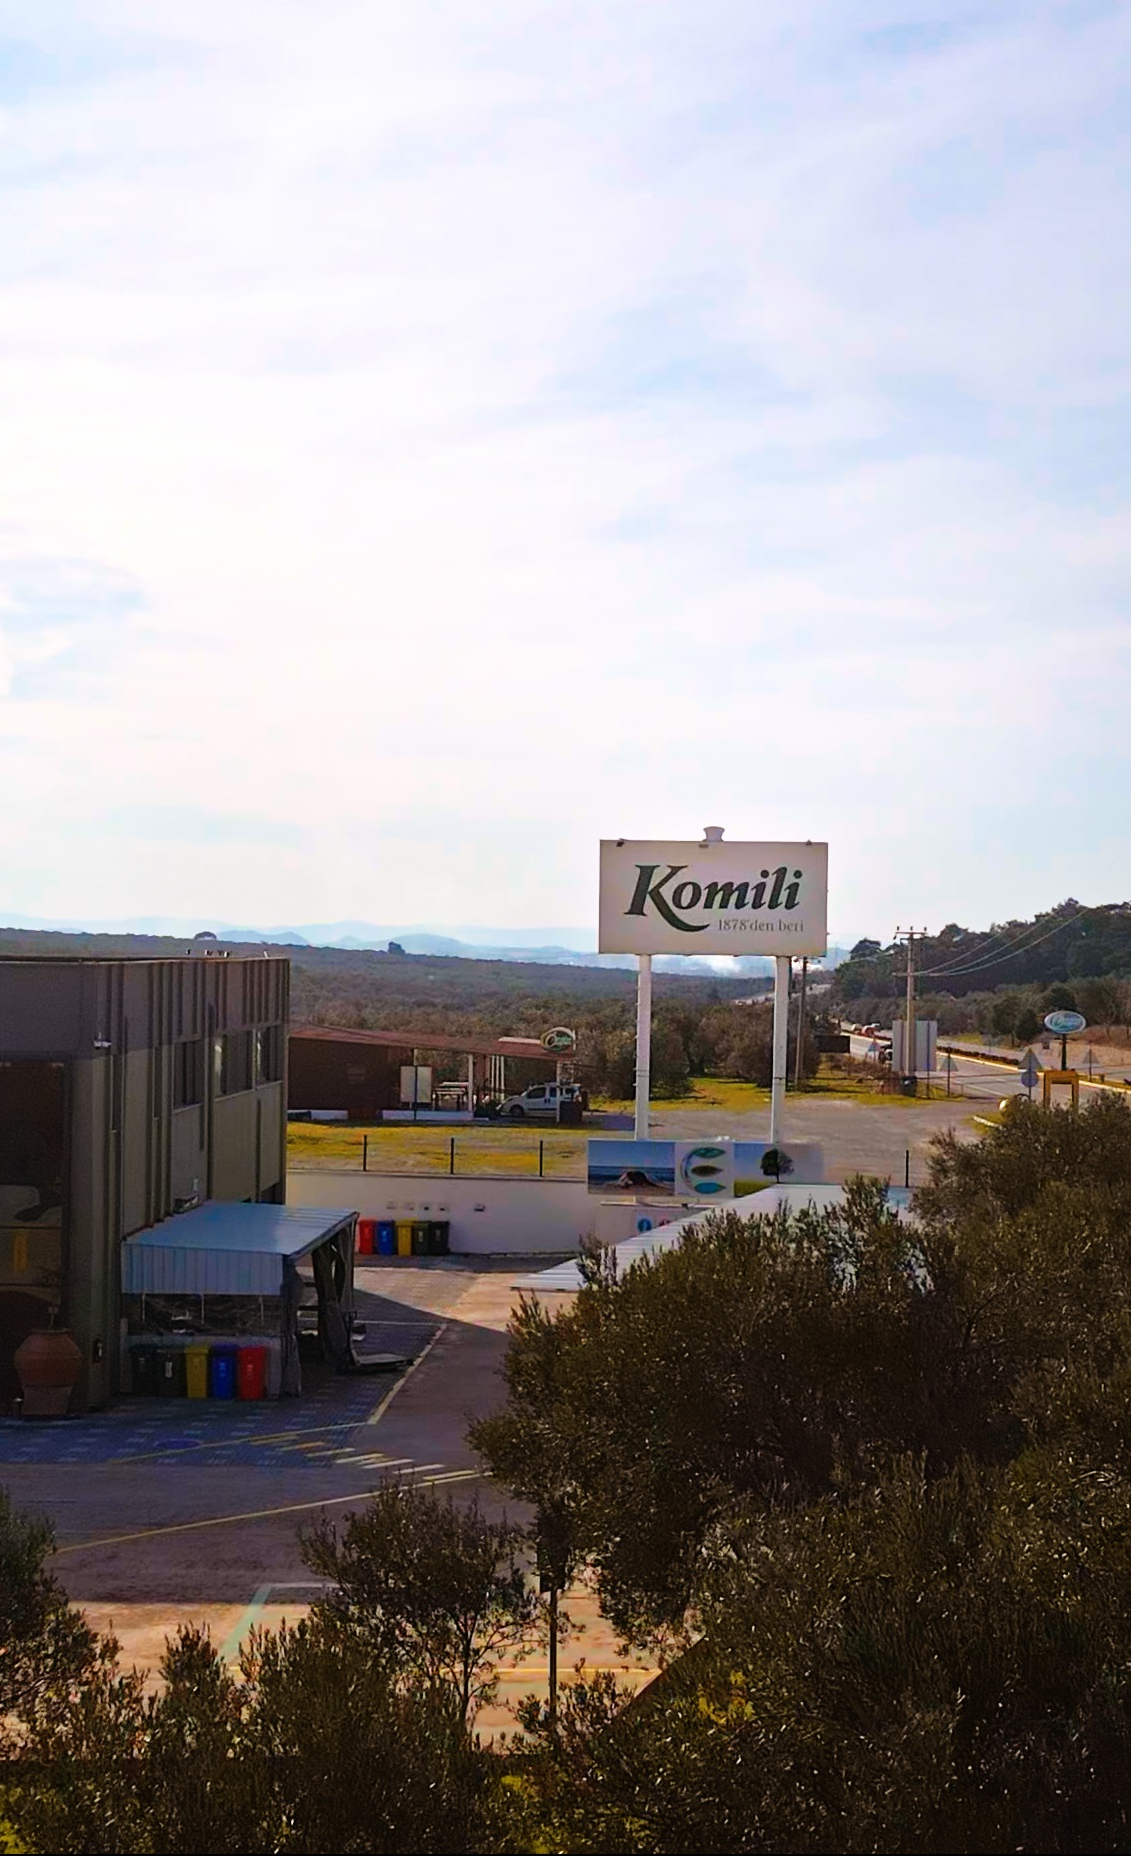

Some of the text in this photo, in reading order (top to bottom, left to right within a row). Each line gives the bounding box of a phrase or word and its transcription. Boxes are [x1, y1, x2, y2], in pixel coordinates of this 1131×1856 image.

[624, 864, 803, 932] Komili
[718, 918, 804, 932] 1878'den beri
